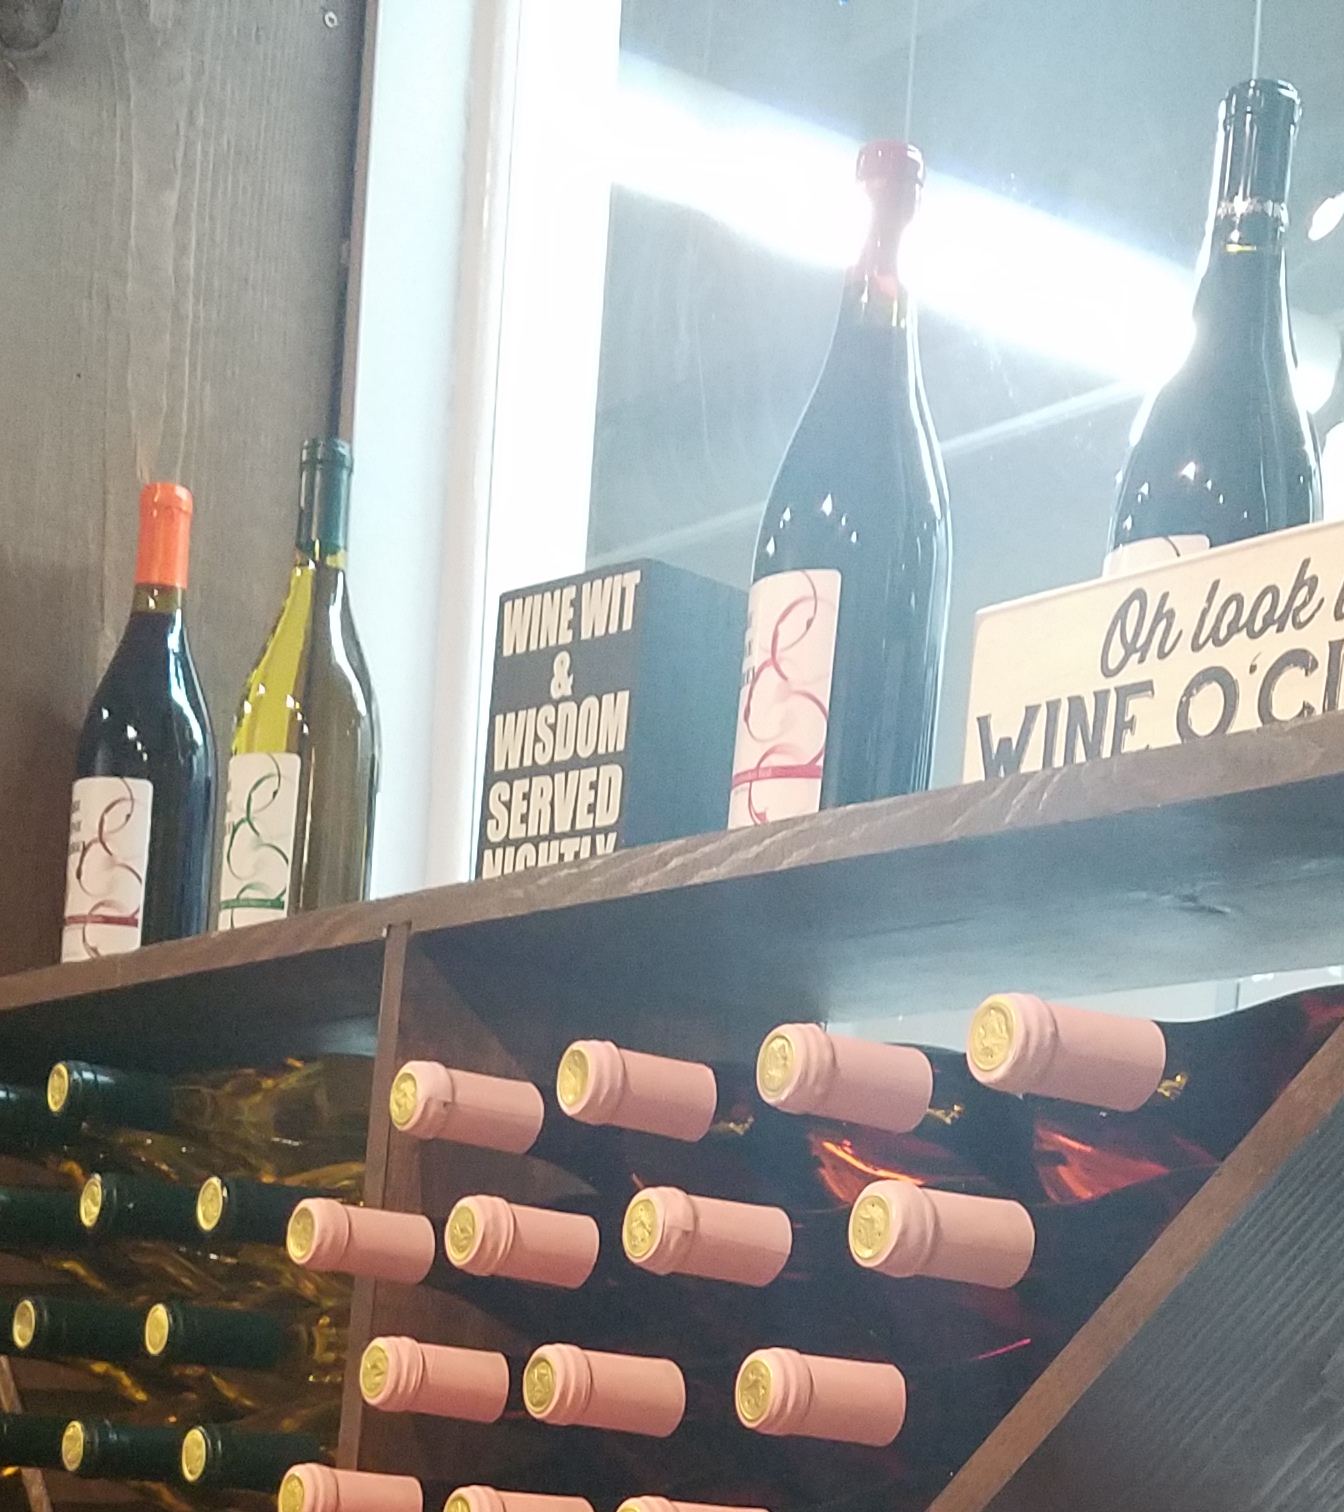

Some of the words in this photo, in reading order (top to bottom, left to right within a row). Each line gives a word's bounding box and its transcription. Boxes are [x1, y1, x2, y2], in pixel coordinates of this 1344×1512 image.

[503, 584, 577, 658] WINE
[580, 569, 642, 641] WIT
[1100, 586, 1184, 679] Oh
[1190, 556, 1325, 653] look
[549, 650, 574, 700] &
[493, 689, 631, 773] WISDOM
[975, 679, 1155, 782] WINE
[486, 763, 624, 843] SERVED
